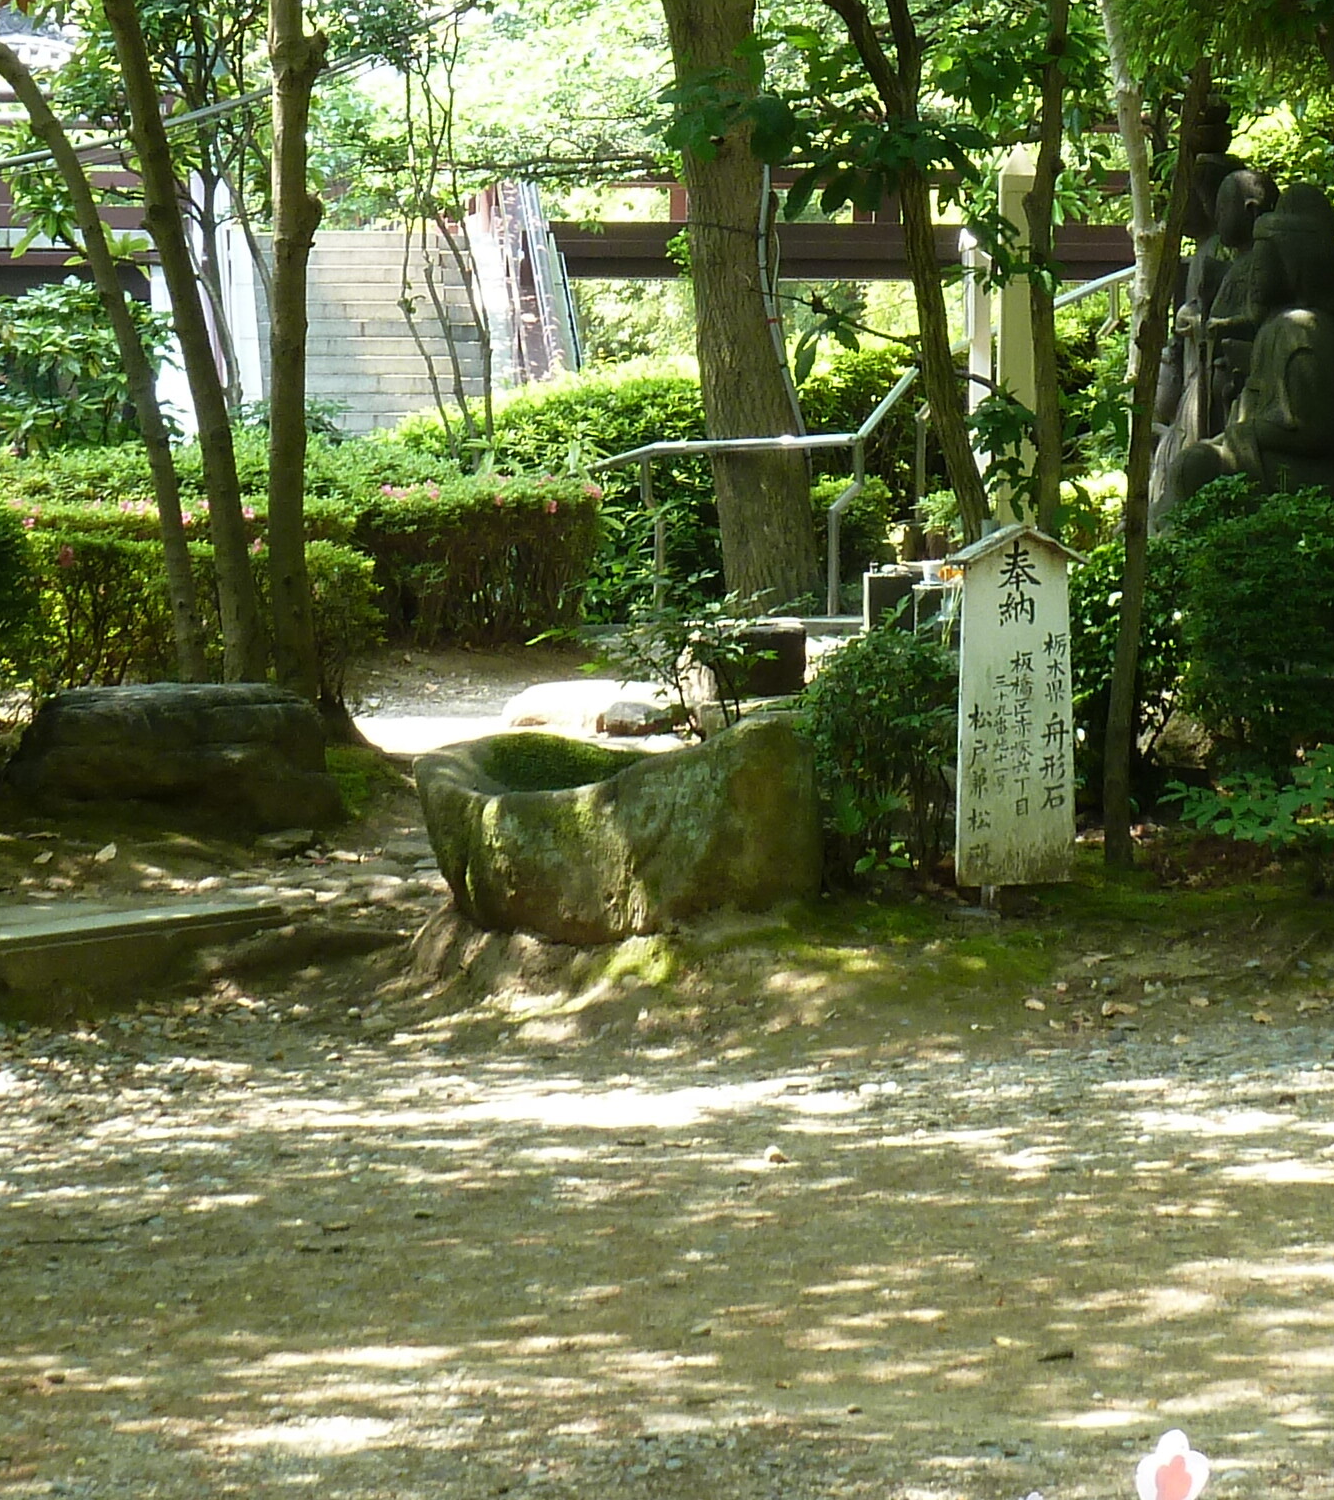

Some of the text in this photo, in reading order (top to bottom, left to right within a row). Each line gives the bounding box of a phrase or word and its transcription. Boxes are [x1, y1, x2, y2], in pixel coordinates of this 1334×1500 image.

[997, 541, 1041, 626] 奉納
[1010, 650, 1034, 817] 板橋区赤塚六丁目
[1038, 632, 1070, 811] 栃木県 舟形石
